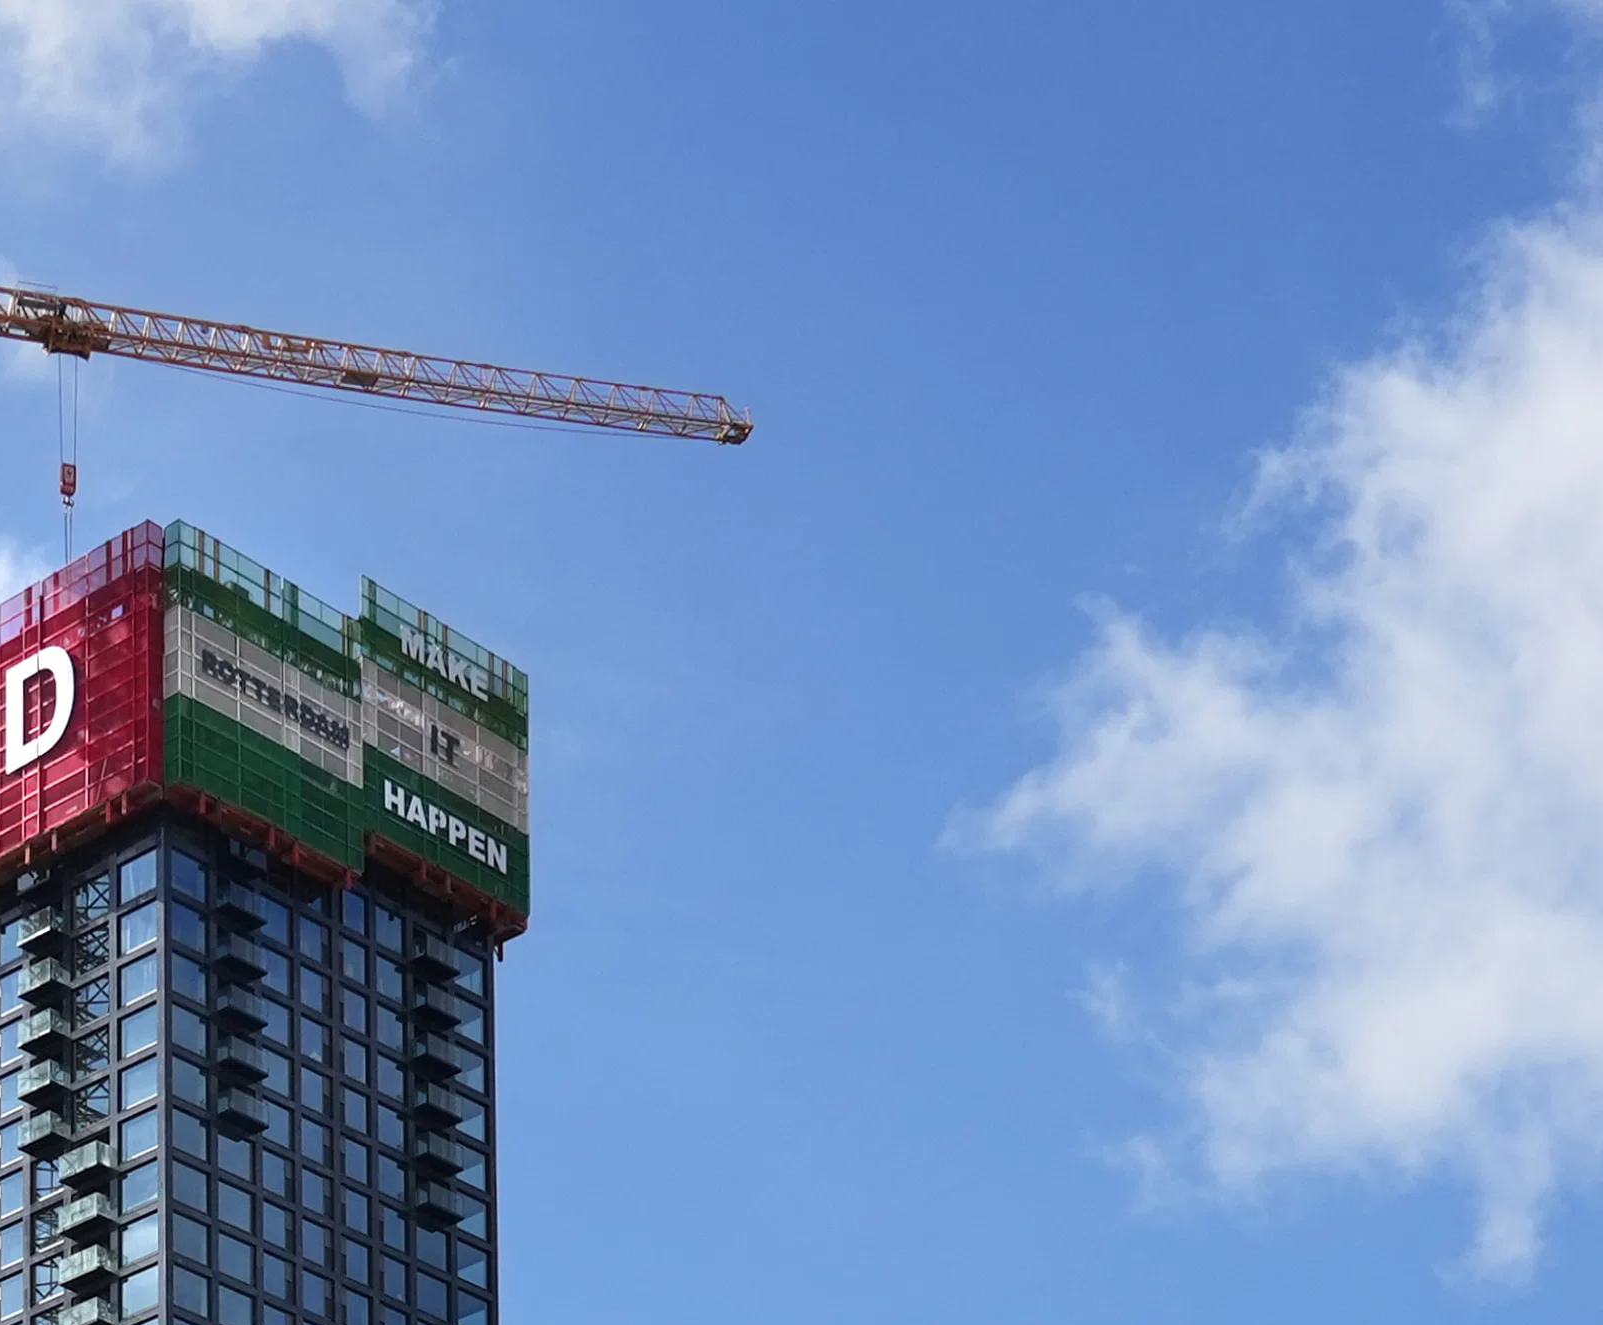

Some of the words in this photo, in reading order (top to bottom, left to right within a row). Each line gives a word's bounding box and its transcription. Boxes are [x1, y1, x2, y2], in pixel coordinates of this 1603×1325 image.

[202, 649, 350, 750] ROTTERDAM
[400, 624, 489, 702] MAKE
[430, 720, 461, 768] IT
[384, 779, 508, 875] HAPPEN
